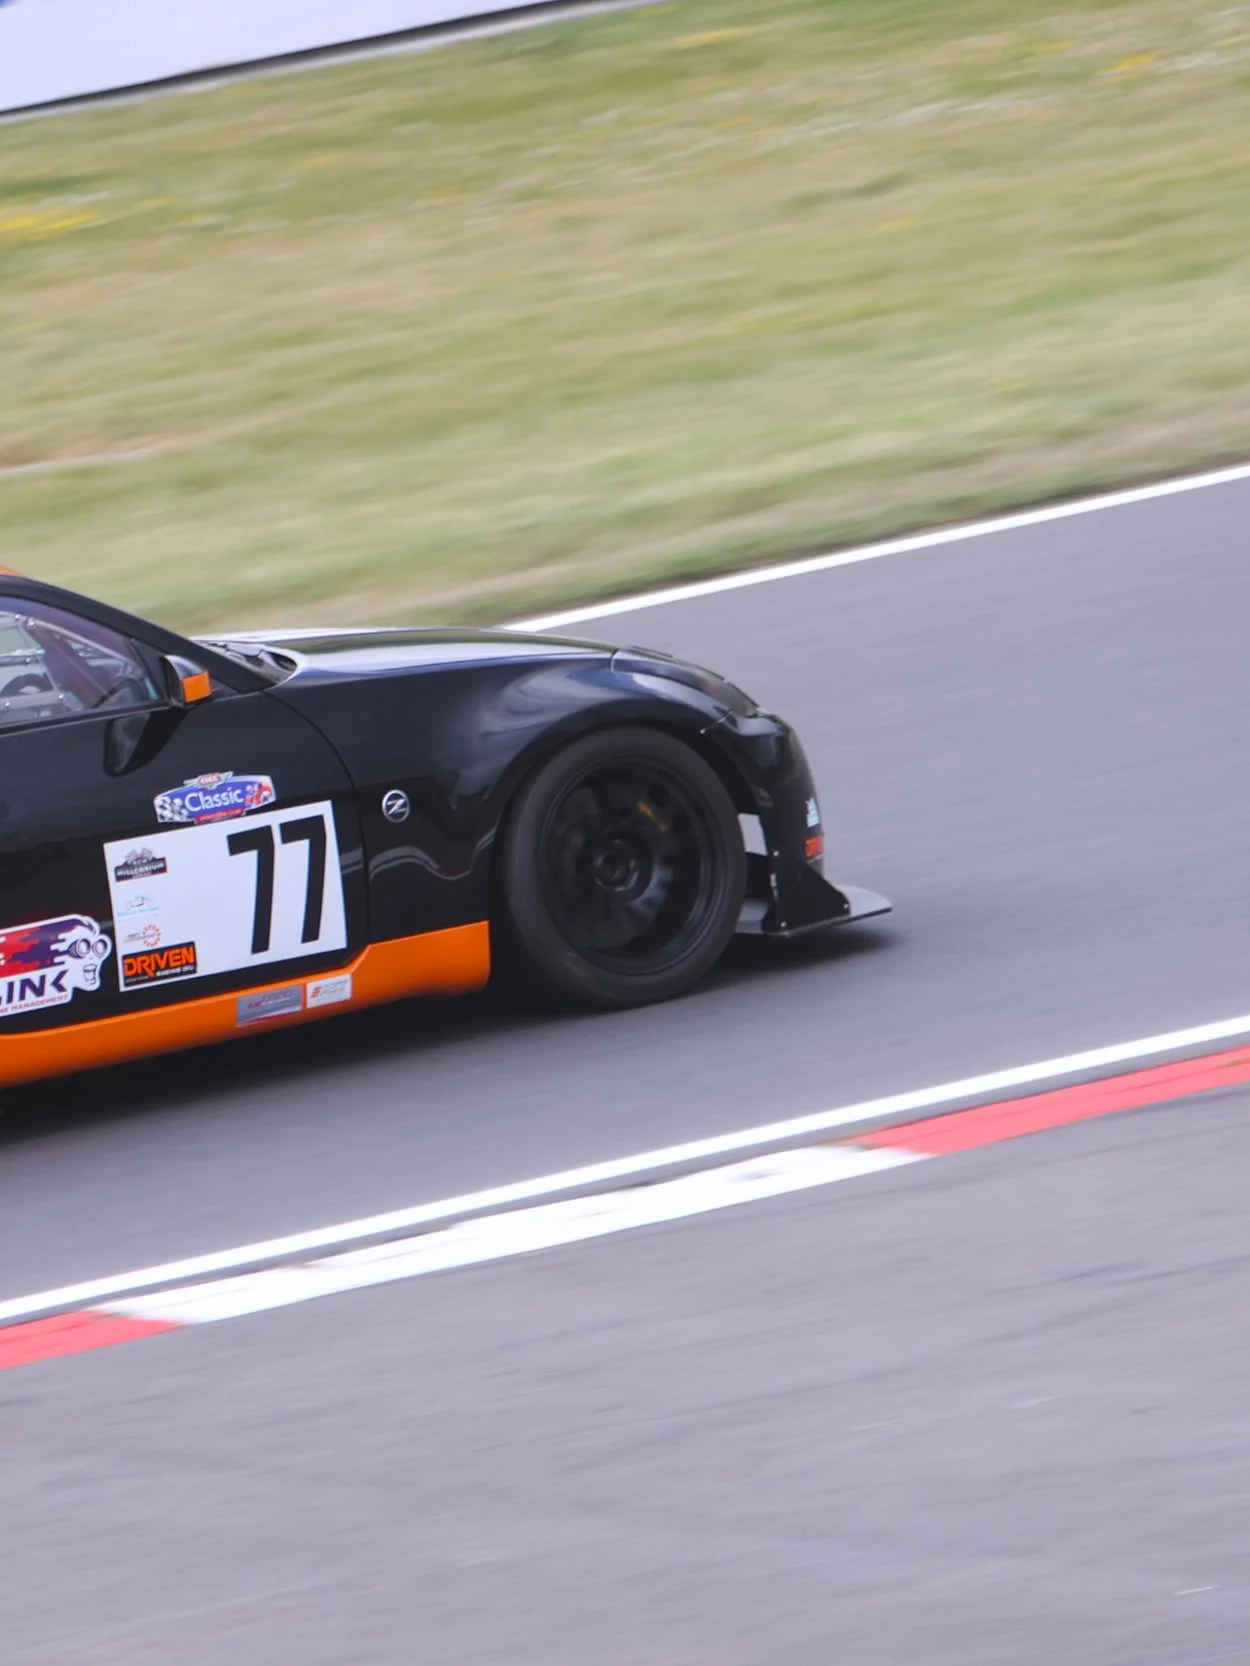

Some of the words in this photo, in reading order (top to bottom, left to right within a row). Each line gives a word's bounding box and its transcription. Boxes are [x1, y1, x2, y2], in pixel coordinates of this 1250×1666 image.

[185, 787, 244, 812] Classic
[226, 814, 327, 955] 77
[124, 946, 195, 977] DRIVEN
